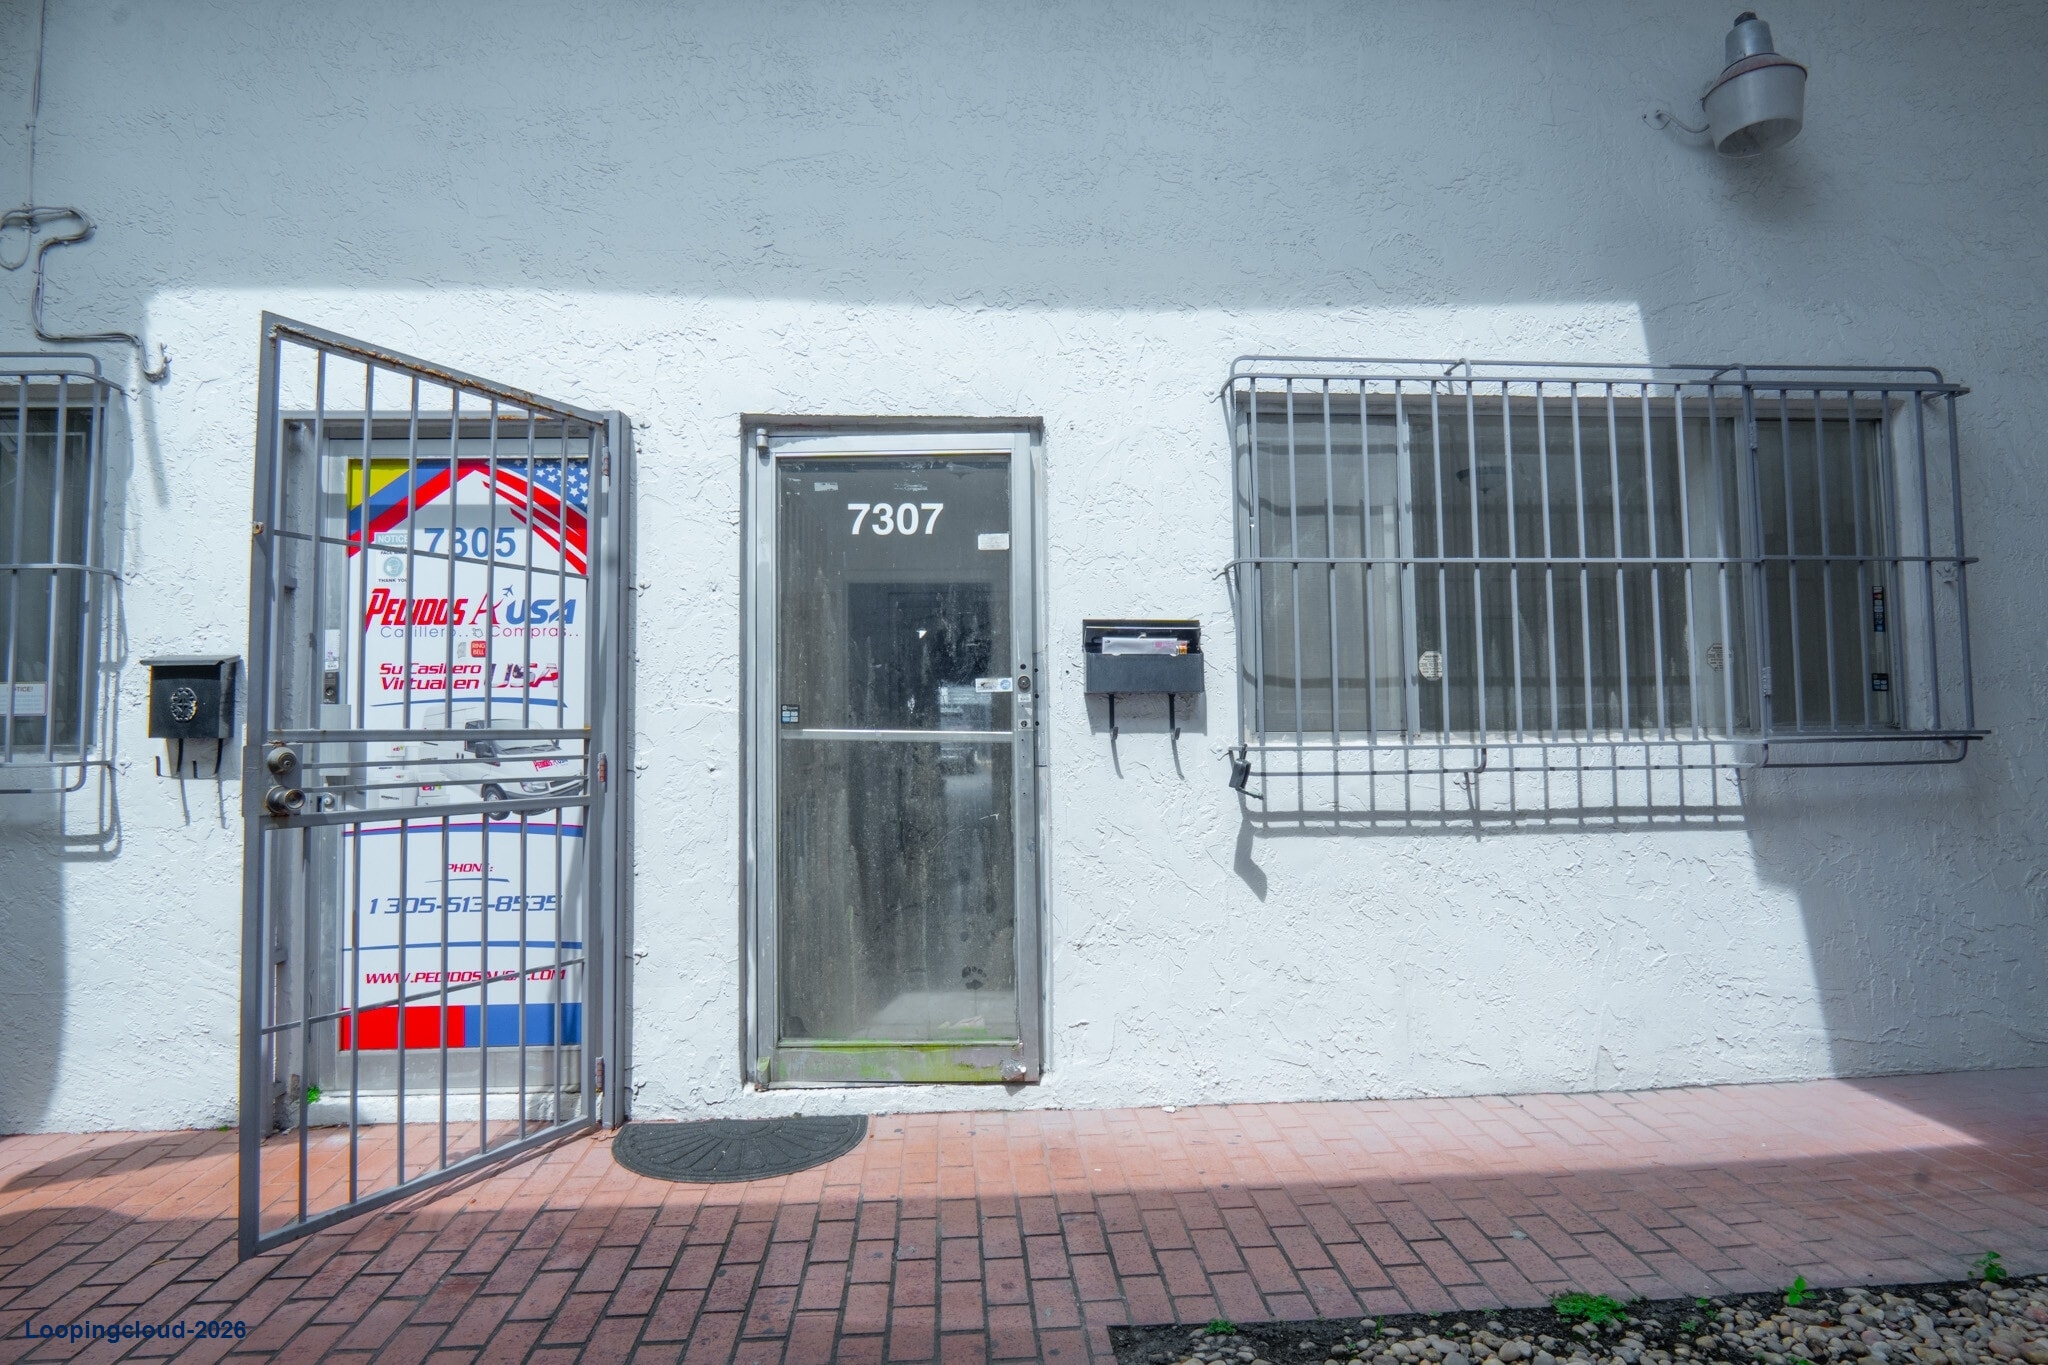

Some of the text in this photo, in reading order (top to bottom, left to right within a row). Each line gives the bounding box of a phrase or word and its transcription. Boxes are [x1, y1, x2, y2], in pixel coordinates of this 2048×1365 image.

[847, 502, 944, 536] 7307
[424, 527, 516, 557] 7305
[469, 592, 504, 625] A
[505, 599, 577, 625] USA
[380, 662, 483, 675] Su Casilero
[381, 663, 560, 690] Virtual en USA
[447, 863, 494, 873] PHON:
[369, 898, 379, 915] 1
